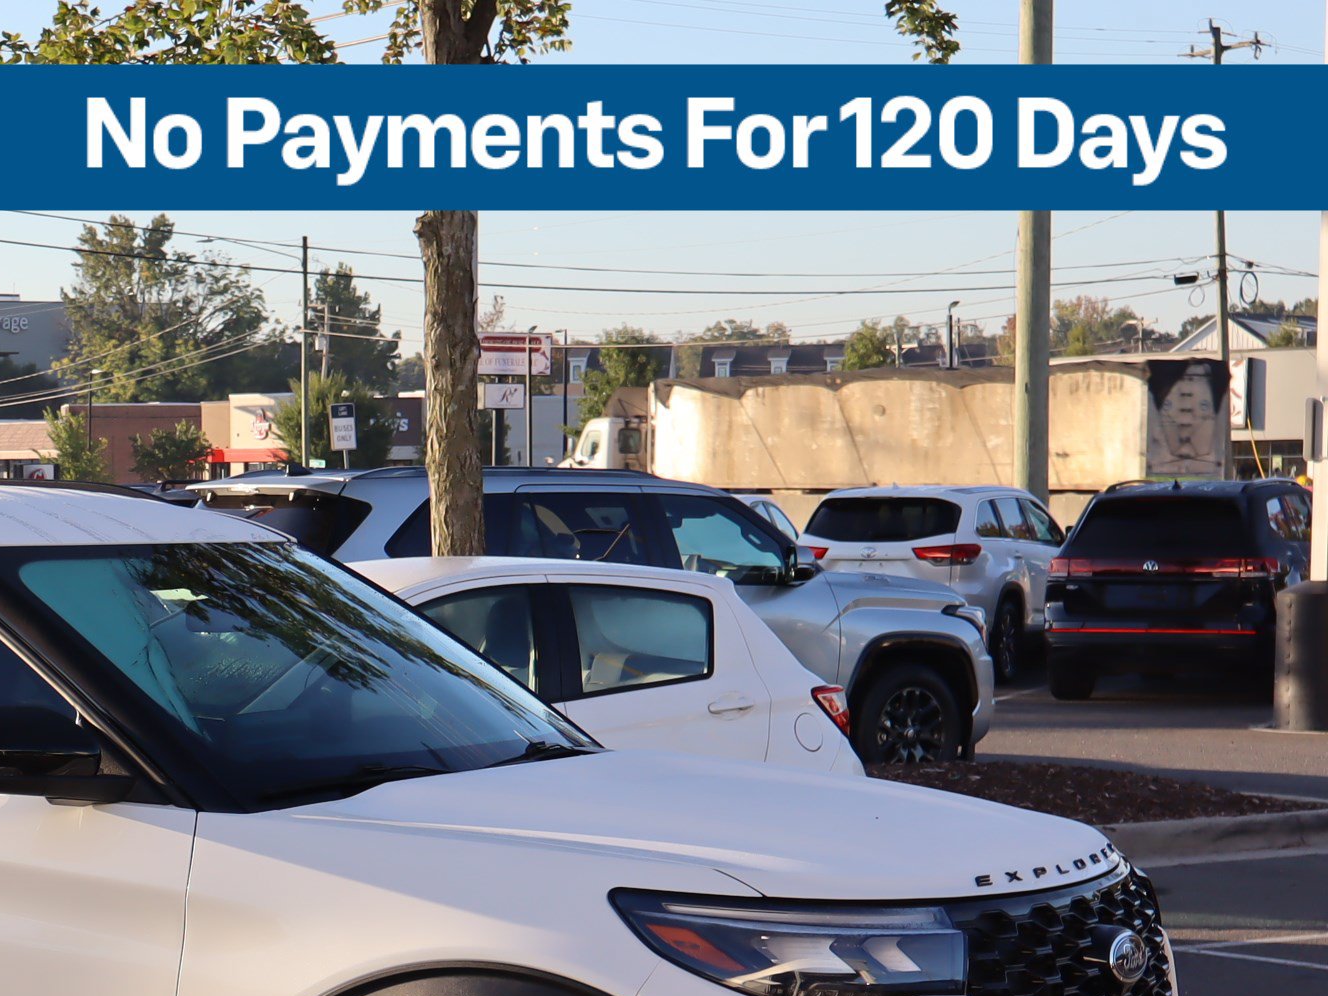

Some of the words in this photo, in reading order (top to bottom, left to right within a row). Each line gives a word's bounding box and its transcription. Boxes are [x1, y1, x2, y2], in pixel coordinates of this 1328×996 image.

[334, 424, 353, 432] BUSES
[336, 433, 352, 442] ONLY
[974, 842, 1116, 888] EXPLORER
